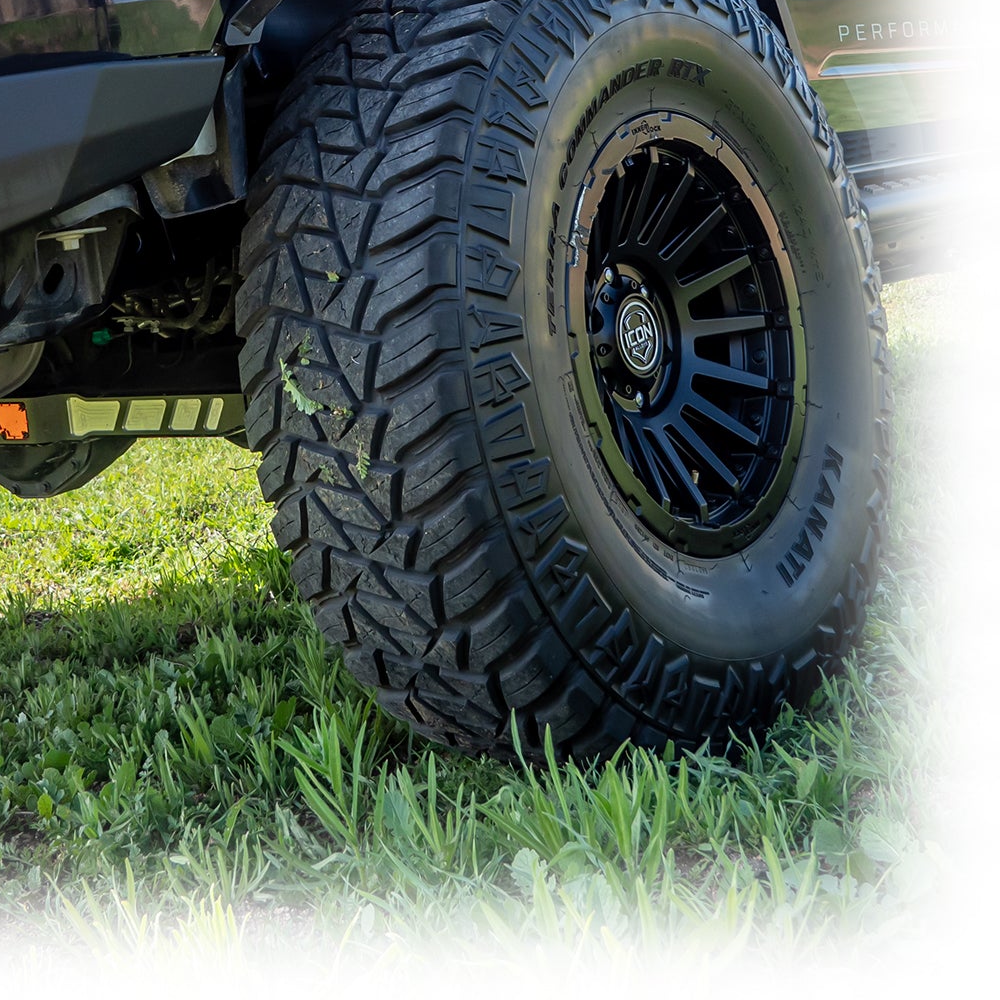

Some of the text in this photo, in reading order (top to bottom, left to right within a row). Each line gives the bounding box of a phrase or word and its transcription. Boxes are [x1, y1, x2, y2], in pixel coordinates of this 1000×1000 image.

[558, 57, 663, 191] COMMANDER
[666, 57, 713, 88] RTX
[624, 321, 654, 349] ICON
[775, 443, 844, 589] KANATI
